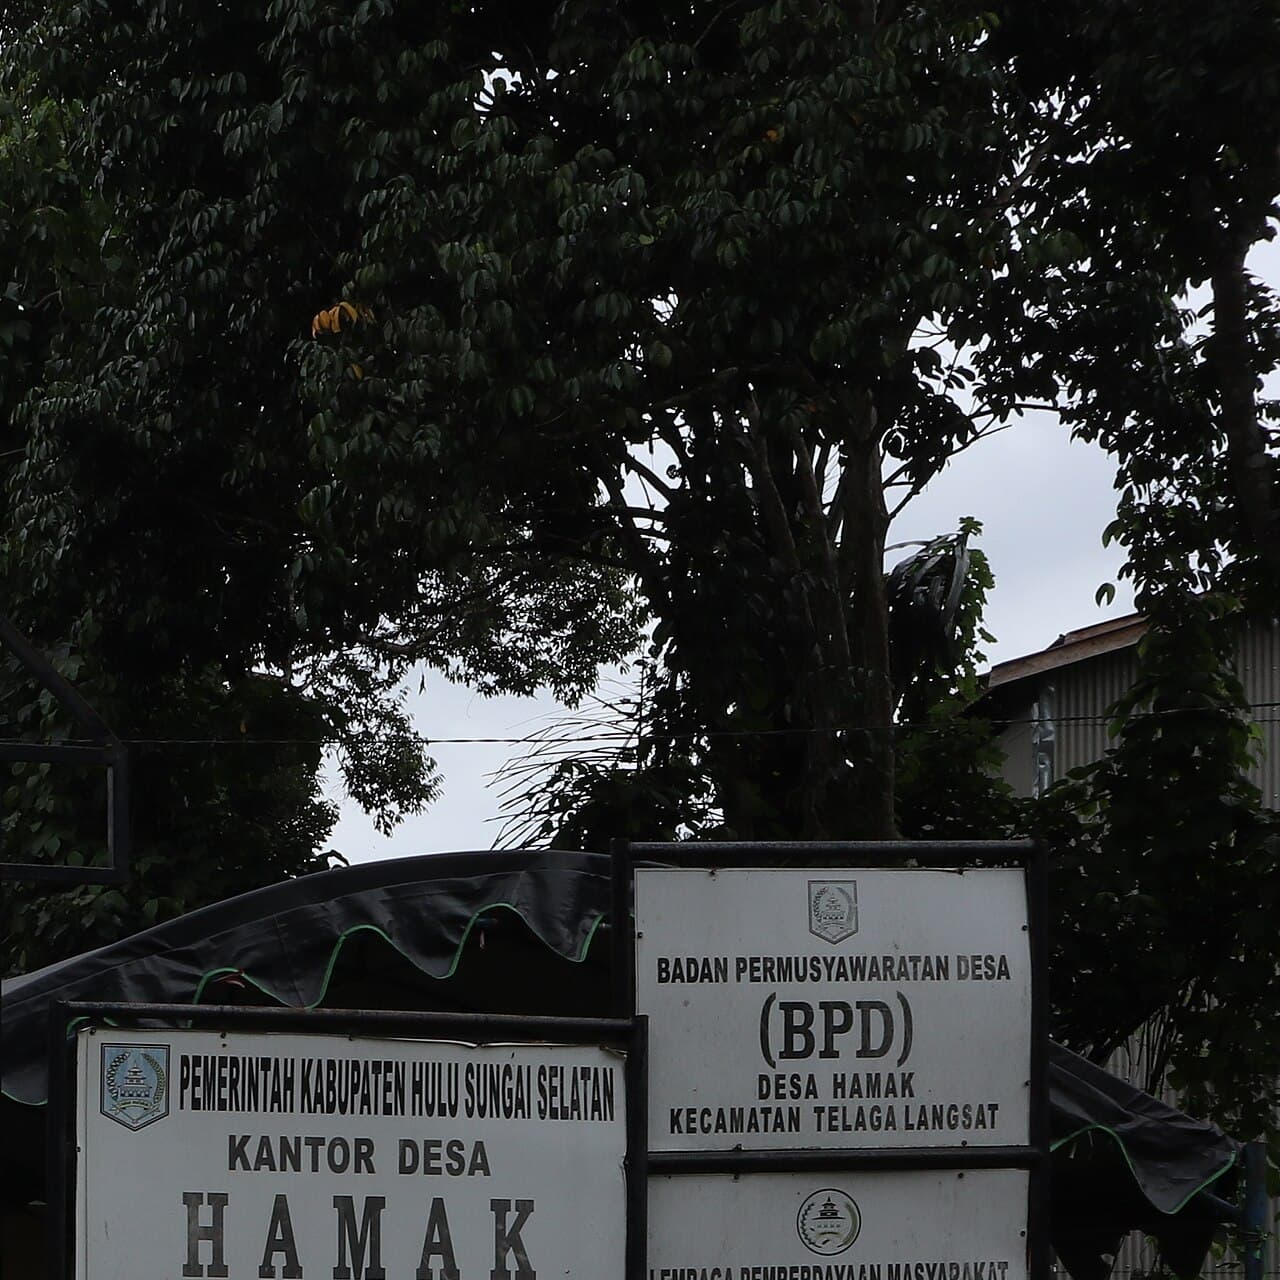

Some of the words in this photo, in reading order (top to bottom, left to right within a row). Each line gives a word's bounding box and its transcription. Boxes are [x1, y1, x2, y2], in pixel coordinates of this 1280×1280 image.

[658, 958, 727, 983] BADAN
[736, 956, 949, 982] PERMUSYAWARATAN
[957, 955, 1010, 980] DESA
[760, 992, 912, 1069] (BPD)
[180, 1055, 294, 1113] PEMERINTAH
[301, 1059, 405, 1116] KABUPATEN
[412, 1062, 458, 1117] HULU
[465, 1063, 531, 1119] SUNGAI
[538, 1065, 614, 1121] SELATAN
[759, 1074, 818, 1100] DESA
[833, 1072, 914, 1099] HAMAK
[671, 1107, 800, 1134] KECAMATAN
[814, 1105, 896, 1131] TELAGA
[905, 1104, 998, 1130] LANGSAT
[229, 1135, 375, 1174] KANTOR
[399, 1139, 490, 1176] DESA
